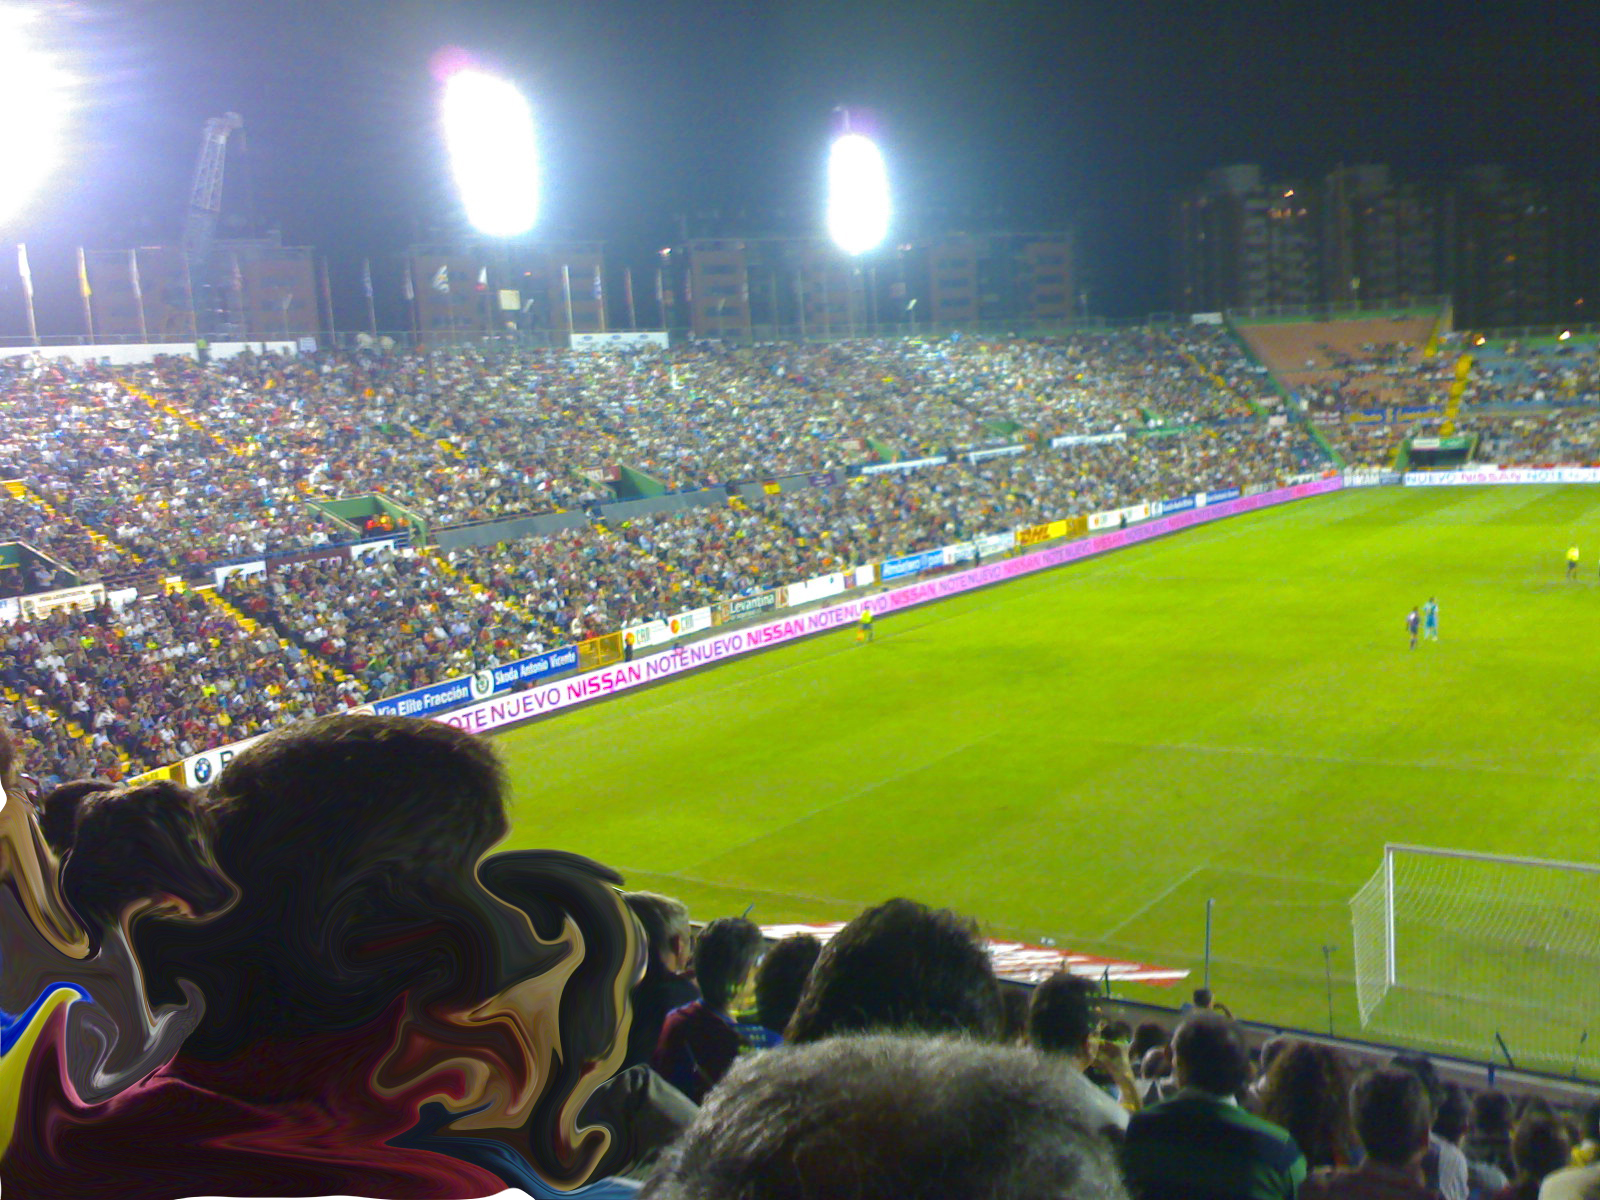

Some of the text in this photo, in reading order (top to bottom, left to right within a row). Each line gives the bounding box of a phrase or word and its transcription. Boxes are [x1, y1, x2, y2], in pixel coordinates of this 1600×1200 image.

[1020, 525, 1051, 546] DHL
[730, 594, 775, 613] Levantina
[447, 707, 488, 732] OTE
[491, 688, 561, 722] NUEVO
[567, 664, 641, 700] NISSAN
[646, 650, 690, 677] NOTE
[690, 635, 743, 663] NUEVO
[746, 619, 805, 647] NISSAN
[808, 608, 843, 630] NOTE
[844, 596, 887, 619] NUEVO
[890, 583, 936, 605] NISSAN
[939, 575, 966, 591] NOTE
[966, 566, 1001, 584] NUEVO
[520, 657, 549, 678] Antonio
[549, 650, 577, 669] Vicente
[397, 697, 423, 716] Elite
[423, 685, 469, 708] Fracción
